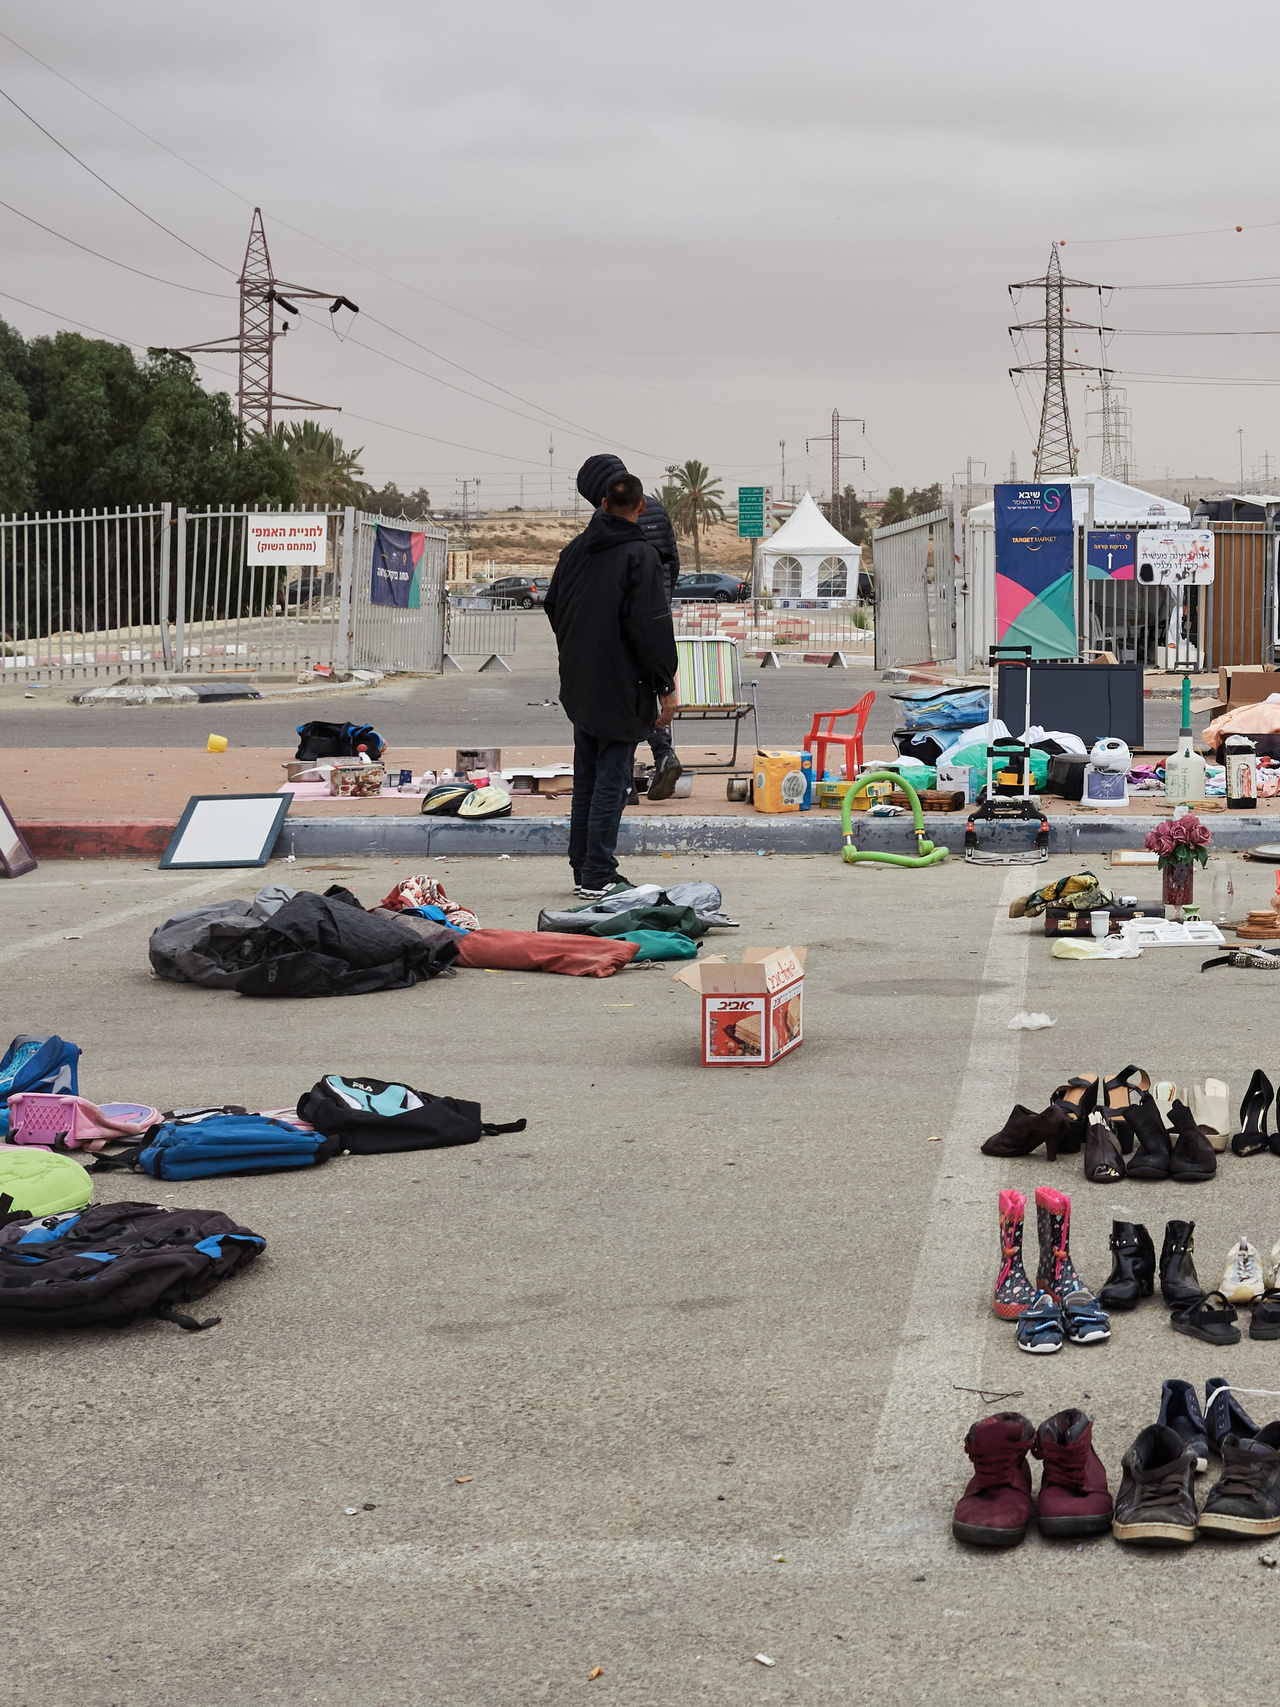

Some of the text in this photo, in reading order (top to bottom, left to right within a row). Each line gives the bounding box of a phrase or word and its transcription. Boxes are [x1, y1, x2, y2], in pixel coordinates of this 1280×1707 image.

[1018, 491, 1041, 499] שיבא
[251, 525, 323, 537] לחניית האמפי
[1141, 552, 1168, 560] מעשית
[717, 1001, 754, 1010] אביב
[352, 1081, 373, 1092] FILA
